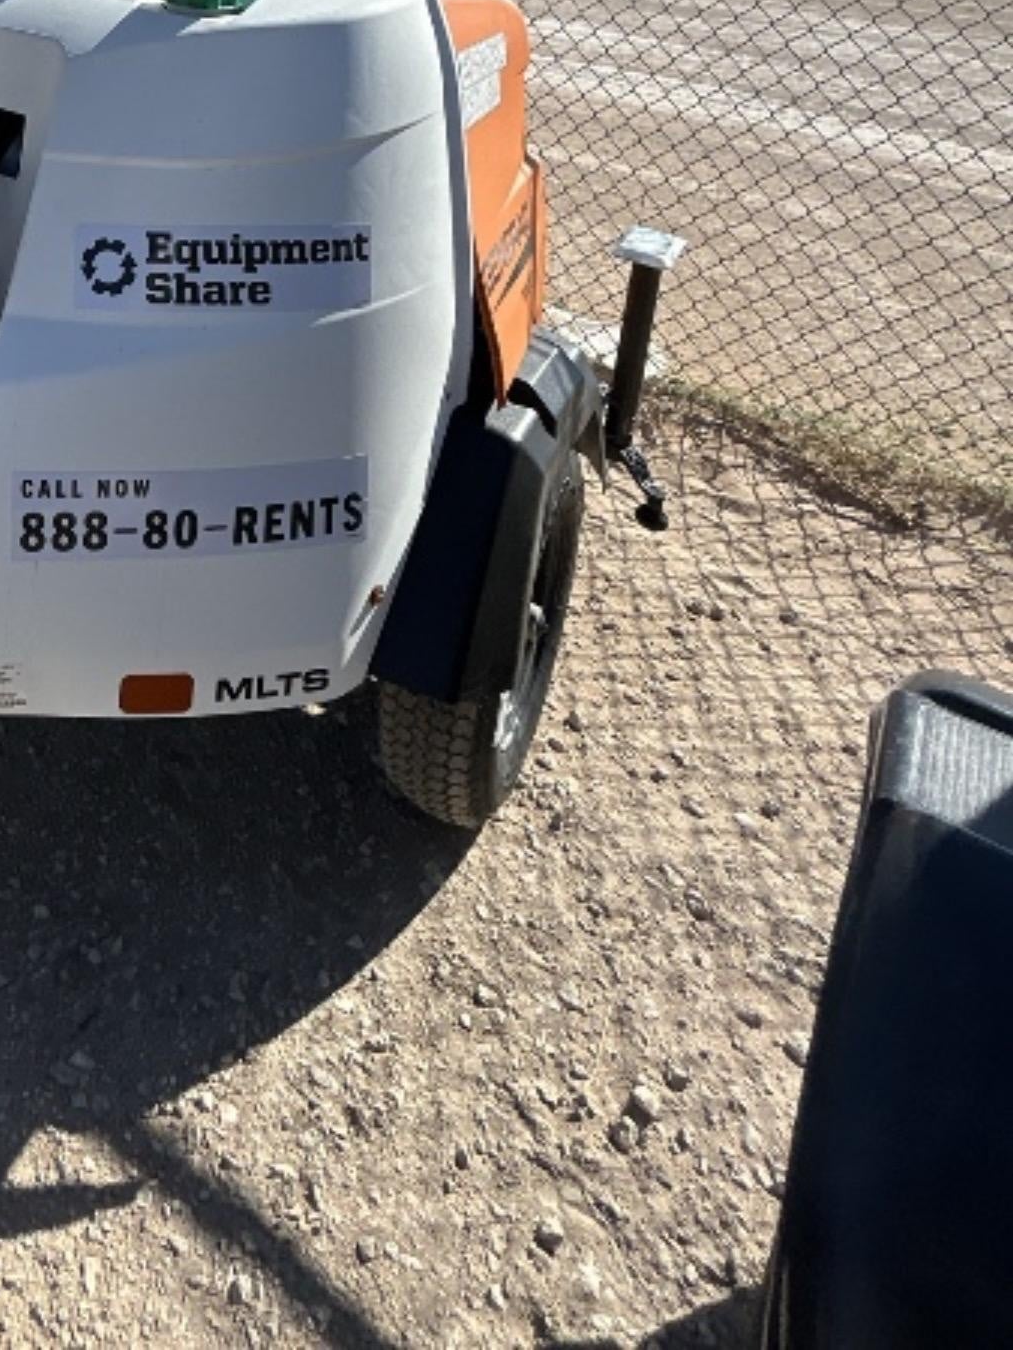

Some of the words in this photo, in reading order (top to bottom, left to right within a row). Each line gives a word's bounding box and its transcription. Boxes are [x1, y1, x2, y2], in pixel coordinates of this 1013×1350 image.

[145, 231, 369, 273] Equipment
[145, 272, 271, 306] Share
[20, 479, 84, 498] CALL
[96, 479, 152, 499] NOW
[19, 492, 364, 553] 888-80-RENTS
[214, 668, 331, 703] MLTS
